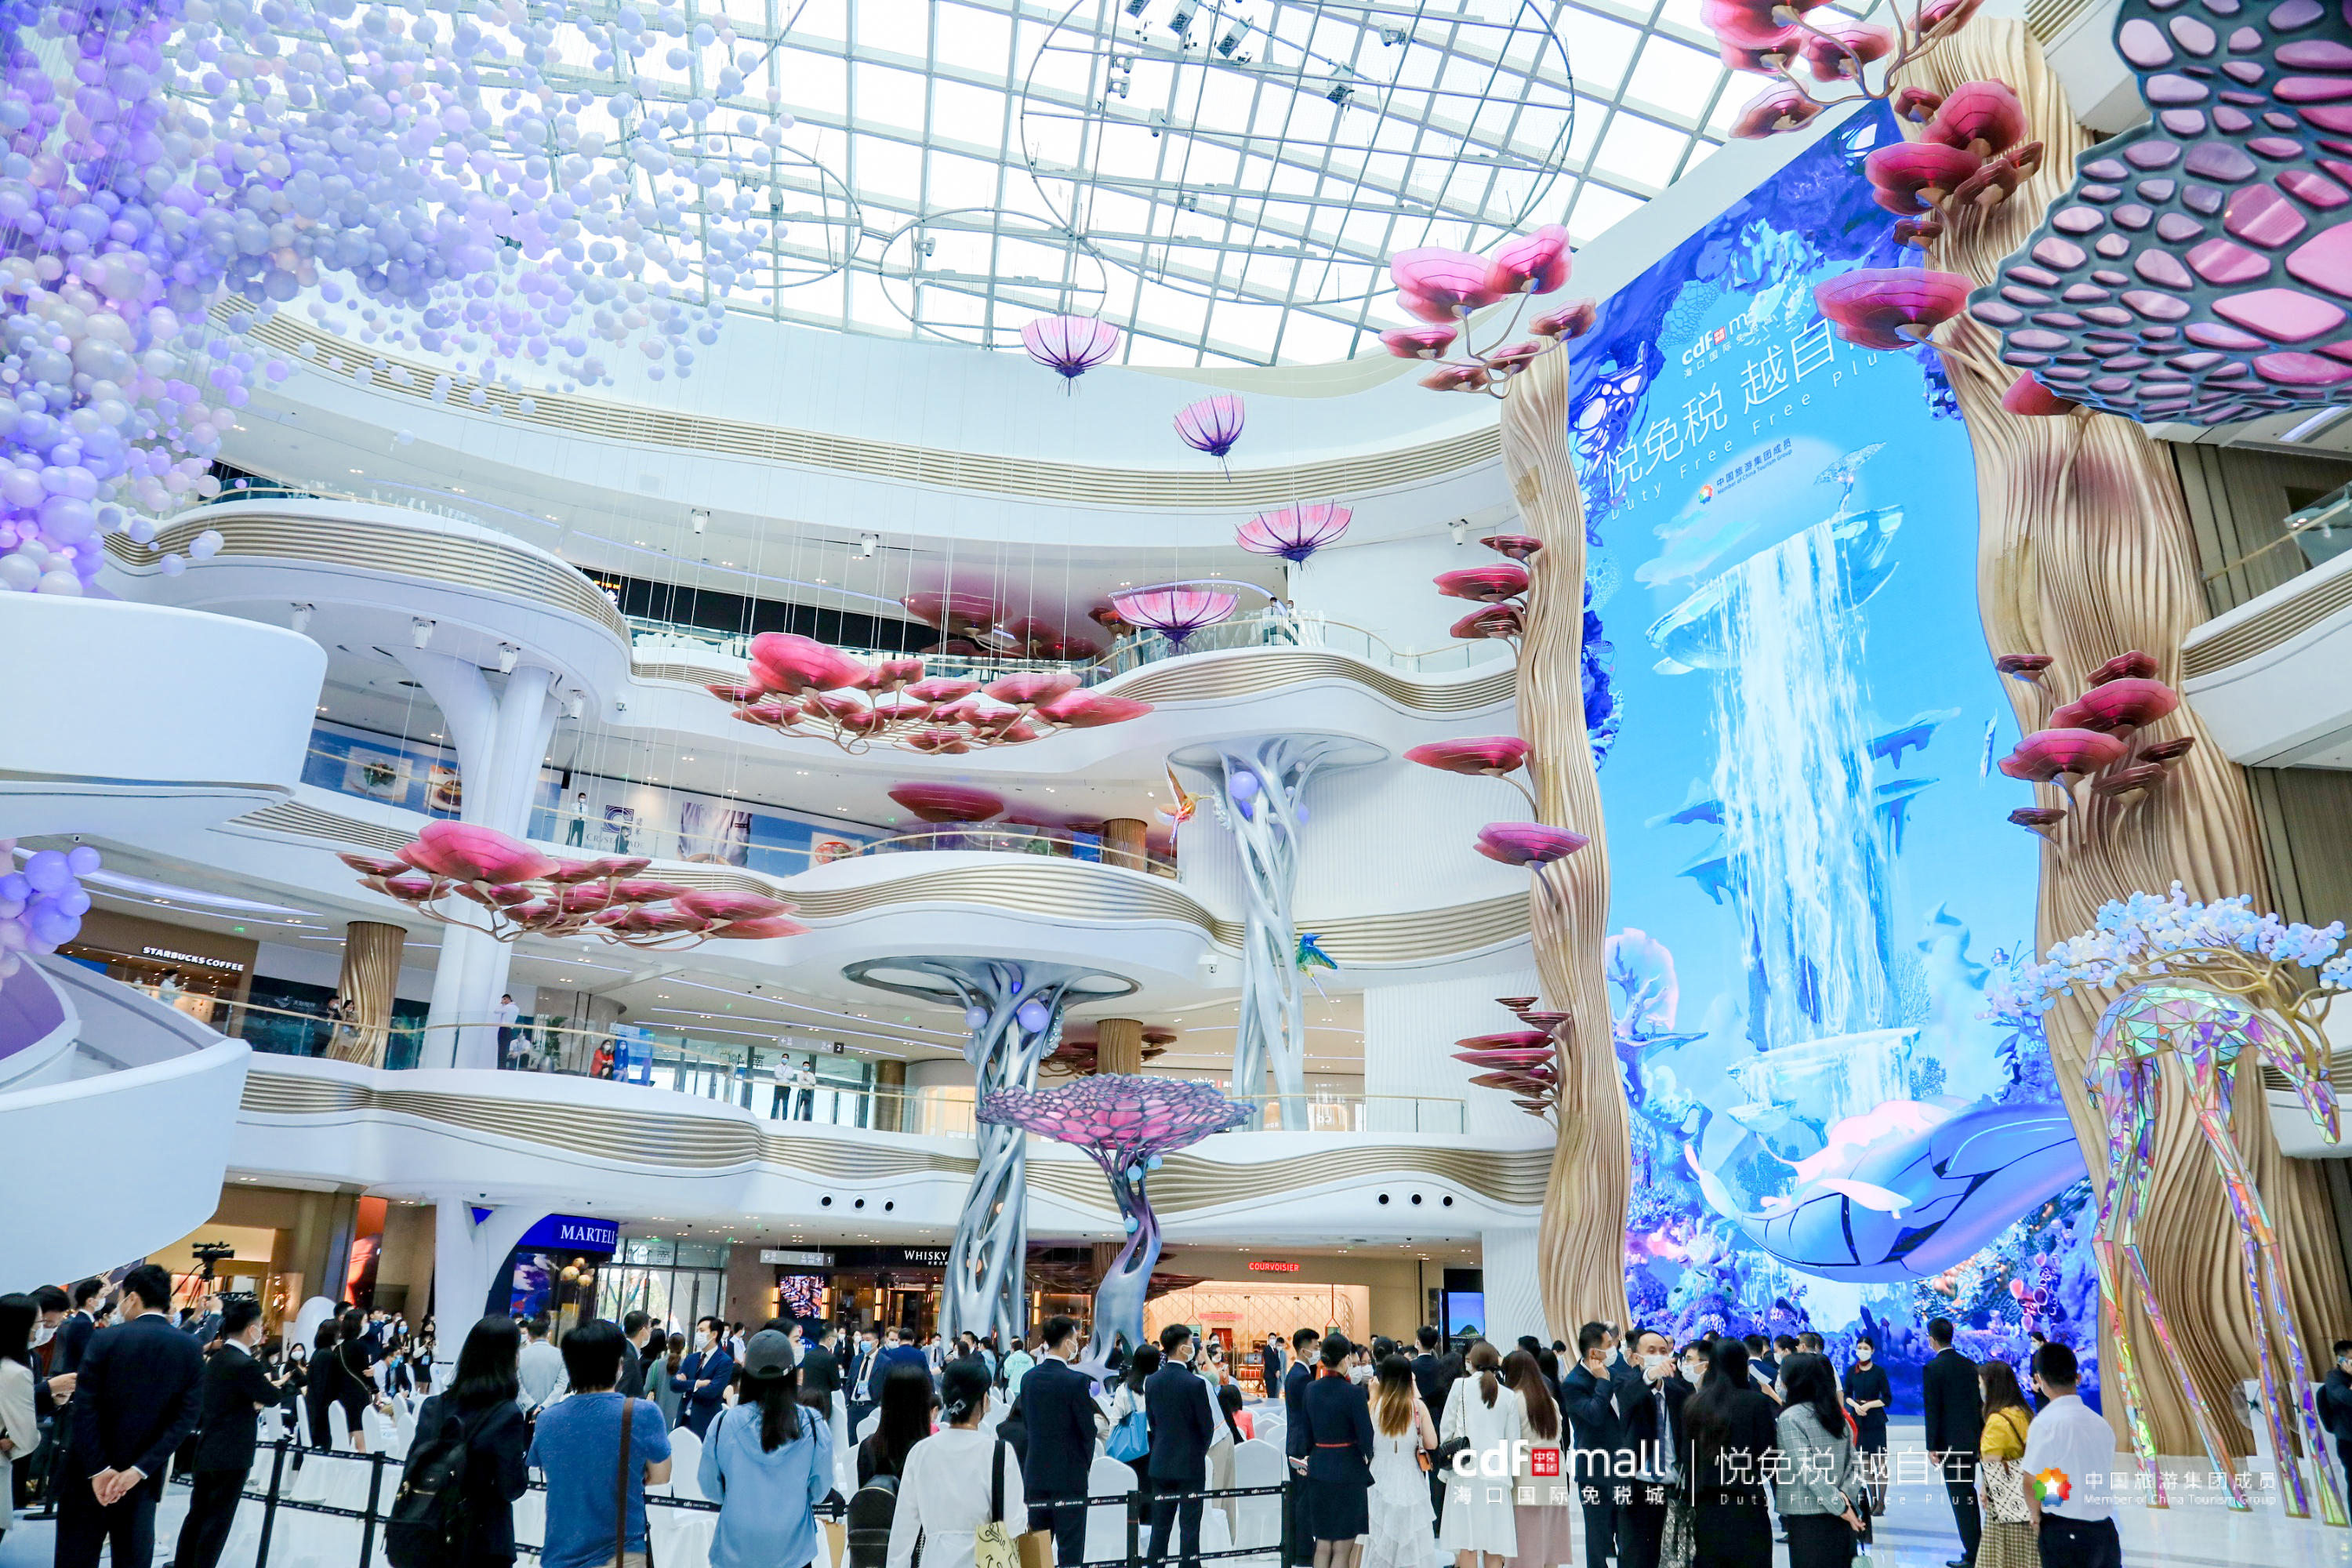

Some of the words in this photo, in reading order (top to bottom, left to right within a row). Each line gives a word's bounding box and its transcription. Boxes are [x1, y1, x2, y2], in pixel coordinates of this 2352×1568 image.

[1682, 330, 1713, 365] cdf
[1603, 382, 1727, 497] 悦免税
[1740, 317, 1853, 415] 越自
[1680, 441, 1732, 479] Free
[1752, 393, 1810, 435] Free
[1833, 350, 1895, 387] Plu
[1717, 438, 1791, 486] 中国旅游集团成员
[1742, 470, 1756, 481] China
[1777, 449, 1792, 461] Group
[586, 833, 616, 844] CRYSTA
[143, 946, 205, 964] STARBUCKS
[205, 958, 245, 971] COFFEE
[560, 1225, 615, 1245] MARTELL
[904, 1250, 948, 1261] WHISKY
[1249, 1262, 1299, 1272] COURVOISIER
